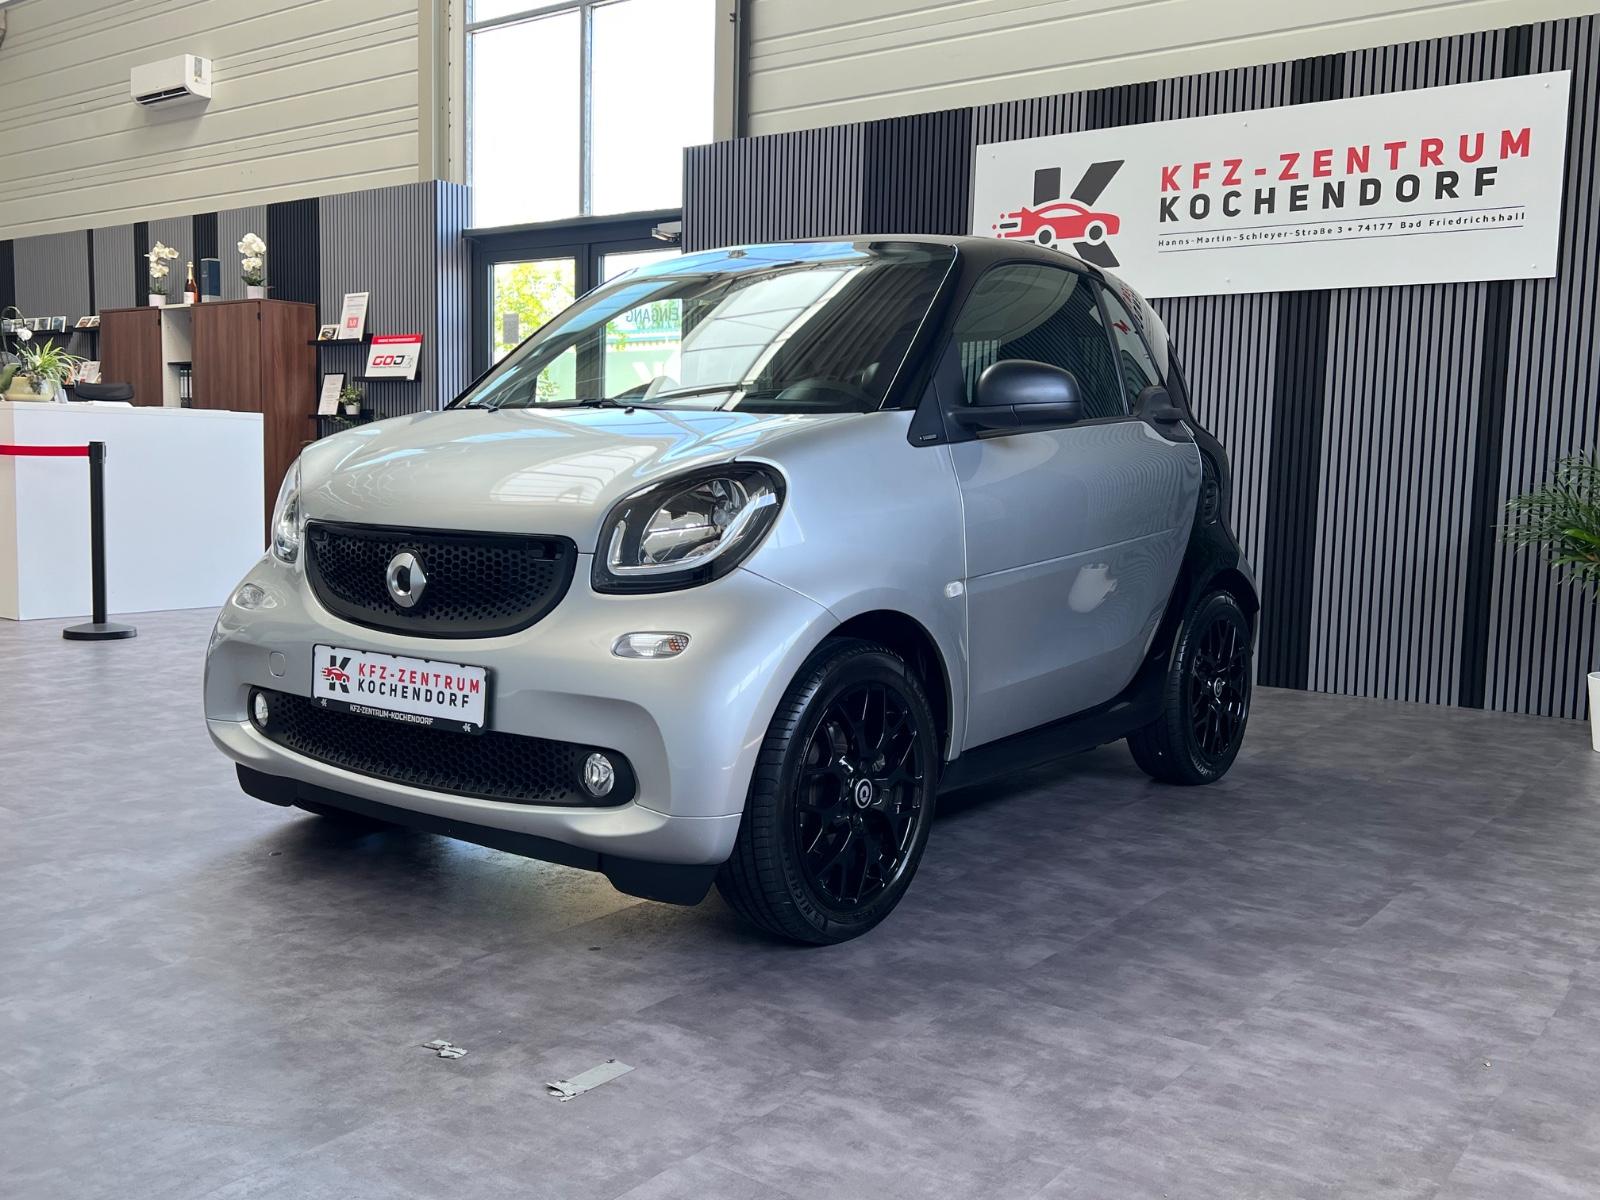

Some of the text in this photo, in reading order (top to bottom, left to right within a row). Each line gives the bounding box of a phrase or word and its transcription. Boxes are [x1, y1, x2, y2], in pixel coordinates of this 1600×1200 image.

[1160, 127, 1531, 192] KFZ-ZENTRUM
[1158, 165, 1498, 223] KOCHENDORF
[1158, 212, 1526, 247] Hanns-Martin-Schleyer-Straße 3 74177 Bad Friedrichshall
[358, 663, 480, 694] KFZ-ZENTRUM
[358, 678, 470, 708] KOCHENDORF
[349, 703, 434, 726] KFZ-ZENTRUM-KOCHENDORF
